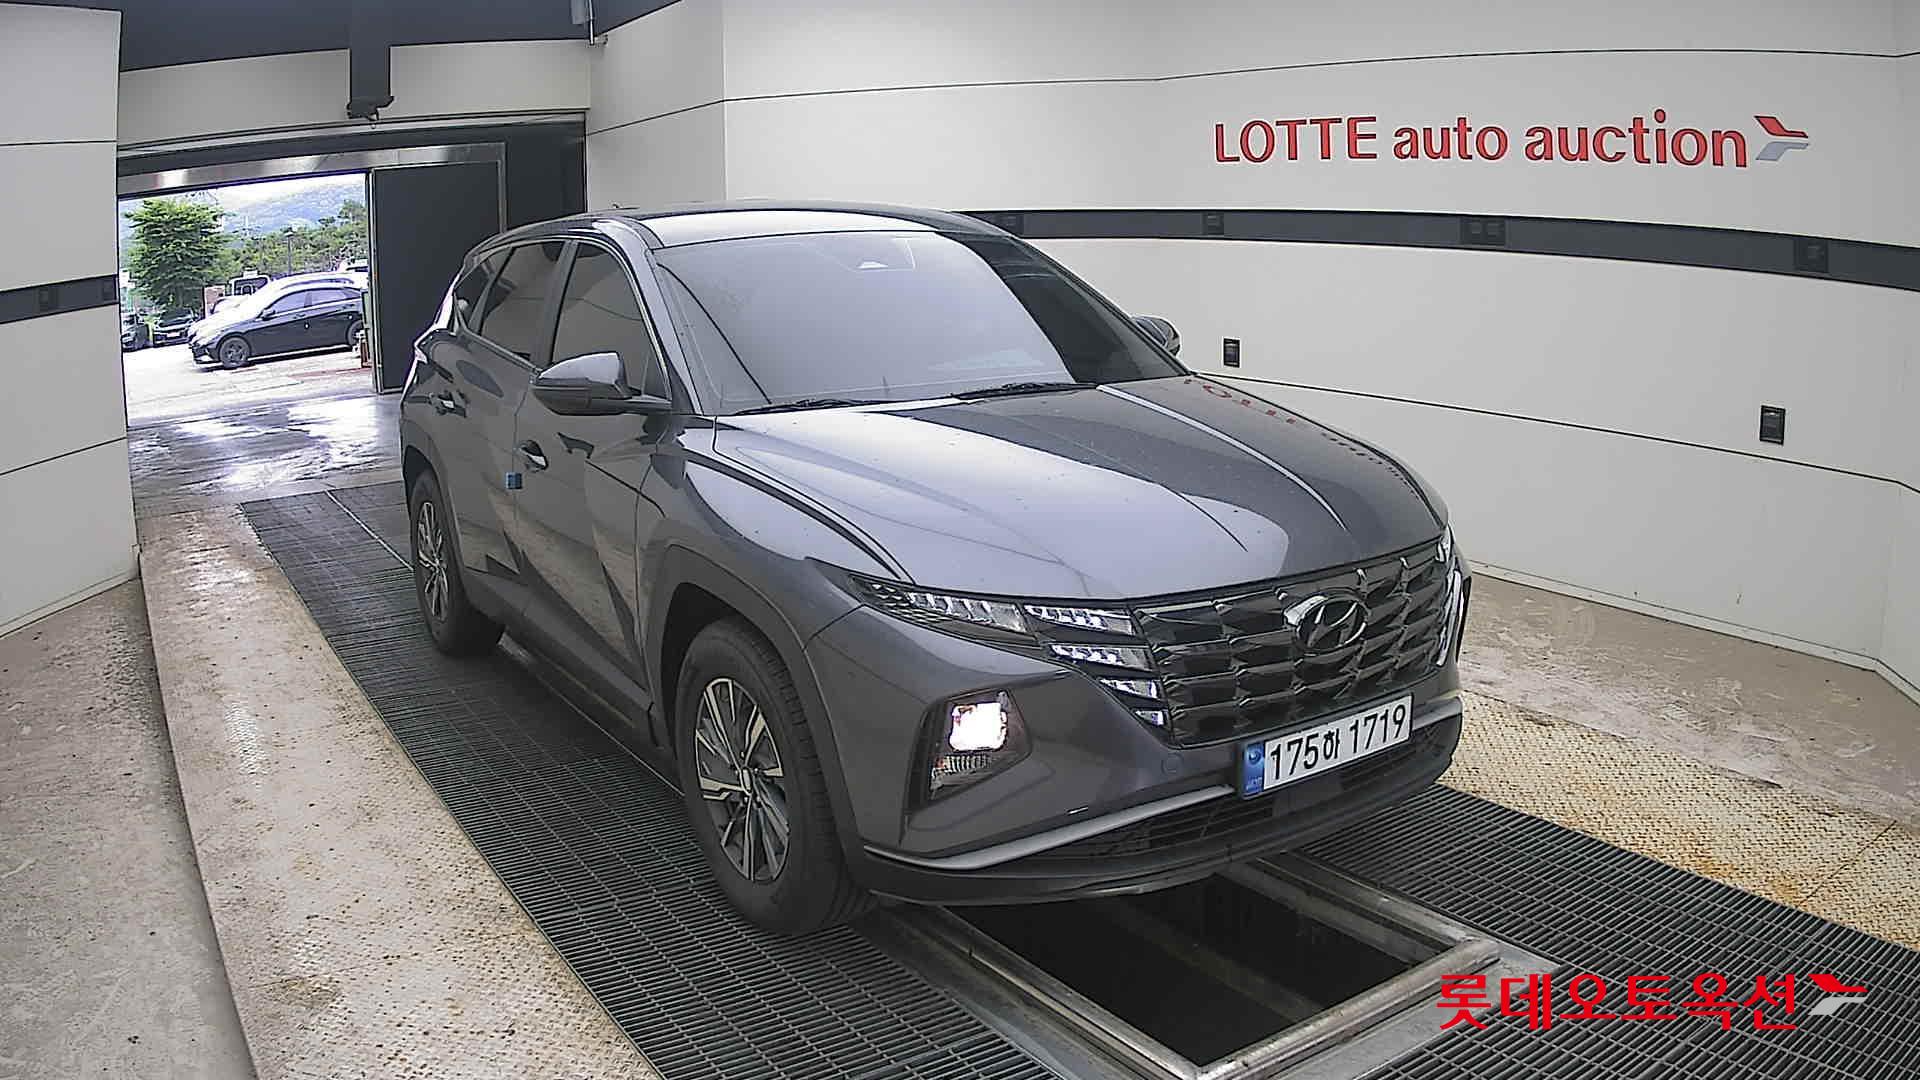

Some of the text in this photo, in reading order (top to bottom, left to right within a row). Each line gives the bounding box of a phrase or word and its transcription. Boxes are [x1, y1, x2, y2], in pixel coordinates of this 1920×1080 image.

[1214, 108, 1748, 168] LOTTE auto auction
[1269, 703, 1407, 781] 175하 1719
